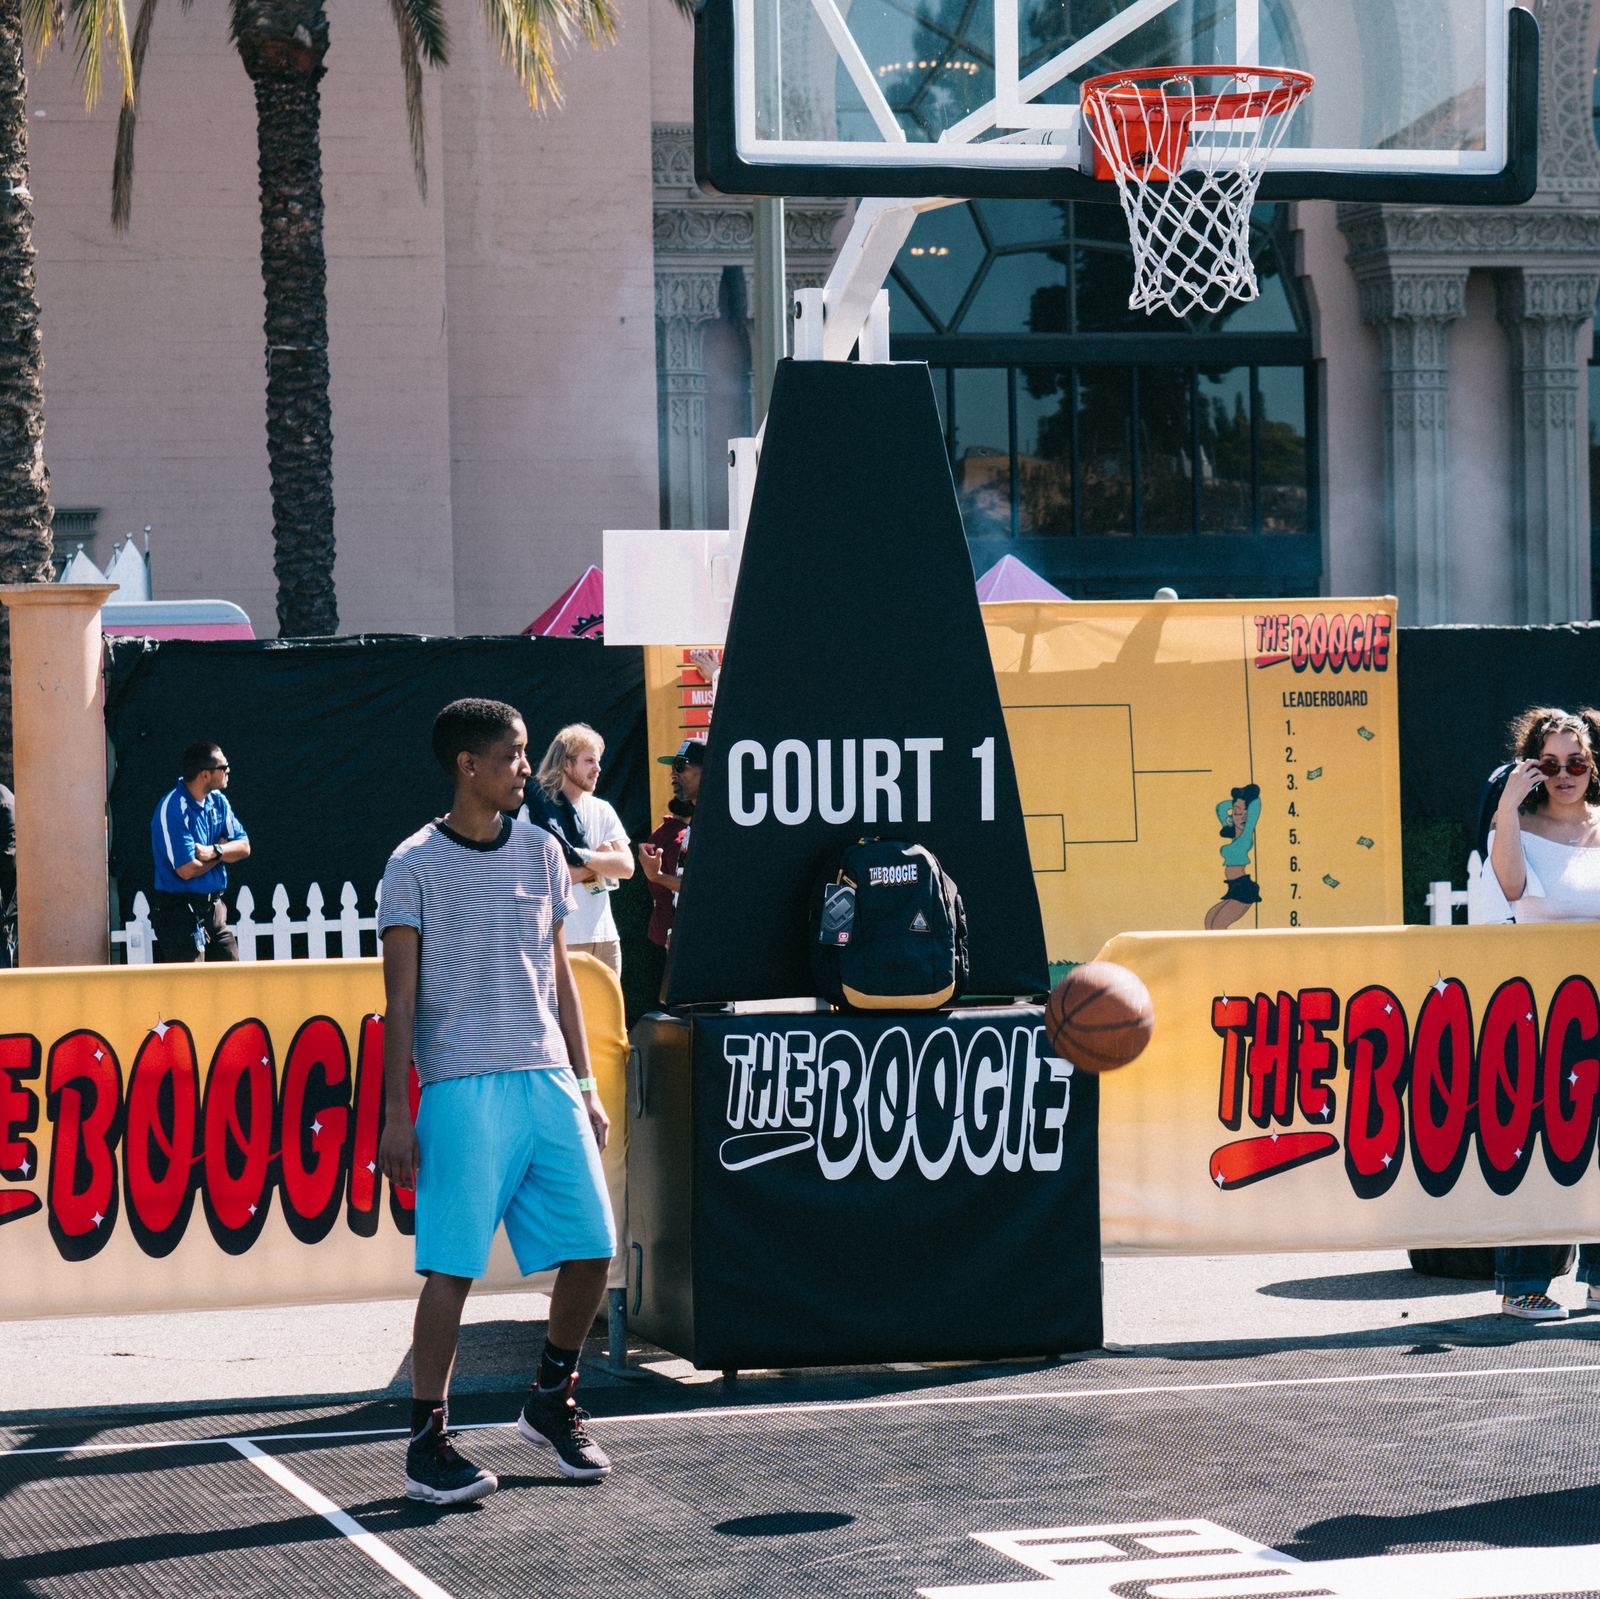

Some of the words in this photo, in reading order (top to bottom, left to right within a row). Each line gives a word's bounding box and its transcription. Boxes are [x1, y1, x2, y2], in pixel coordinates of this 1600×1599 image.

[1254, 615, 1290, 652] THE
[1290, 613, 1391, 674] BOOGIE
[1282, 690, 1368, 708] LEADERBOARD
[1285, 719, 1296, 736] 1.
[1285, 746, 1297, 763] 2.
[727, 737, 944, 827] COURT
[971, 736, 995, 821] 1
[1286, 773, 1298, 790] 3.
[1287, 801, 1300, 817] 4.
[1289, 828, 1301, 845] 5.
[1290, 856, 1301, 872] 6.
[868, 866, 882, 880] THE
[882, 863, 918, 887] BOOGIE
[1290, 883, 1302, 900] 7.
[1290, 910, 1301, 927] 8.
[1210, 987, 1340, 1132] THE
[1344, 973, 1600, 1200] BOOG
[723, 1031, 817, 1130] THE
[816, 1026, 1076, 1181] BOOGIE
[46, 1012, 416, 1263] BOOGI
